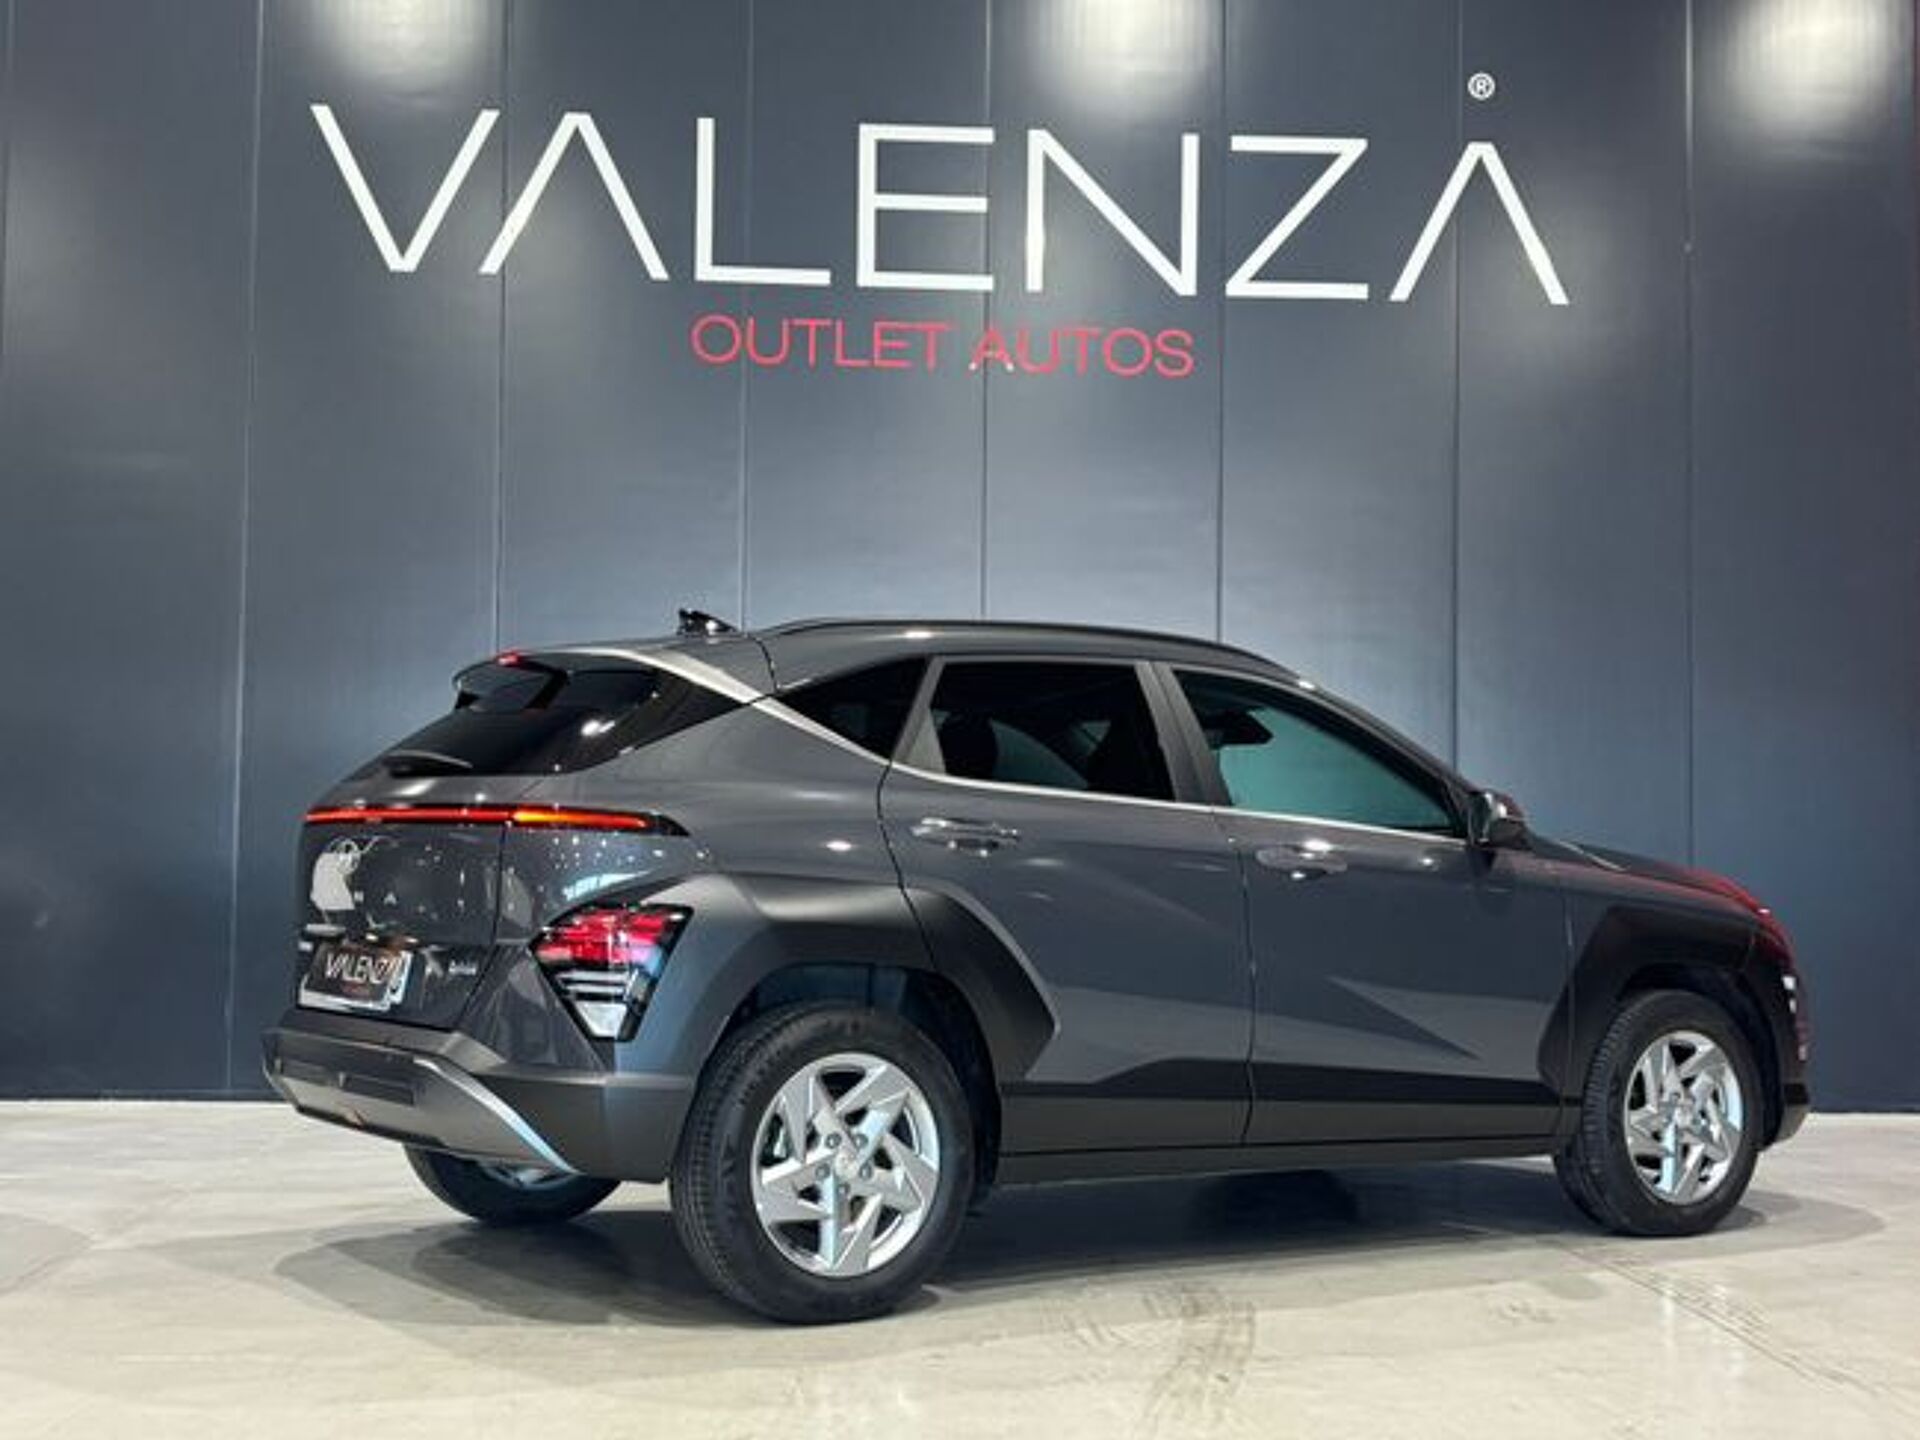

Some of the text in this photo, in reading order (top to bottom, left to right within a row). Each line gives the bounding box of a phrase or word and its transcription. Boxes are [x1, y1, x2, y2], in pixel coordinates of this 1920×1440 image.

[311, 103, 1569, 305] VALENZA
[690, 315, 1196, 379] OUTLET AUTOS
